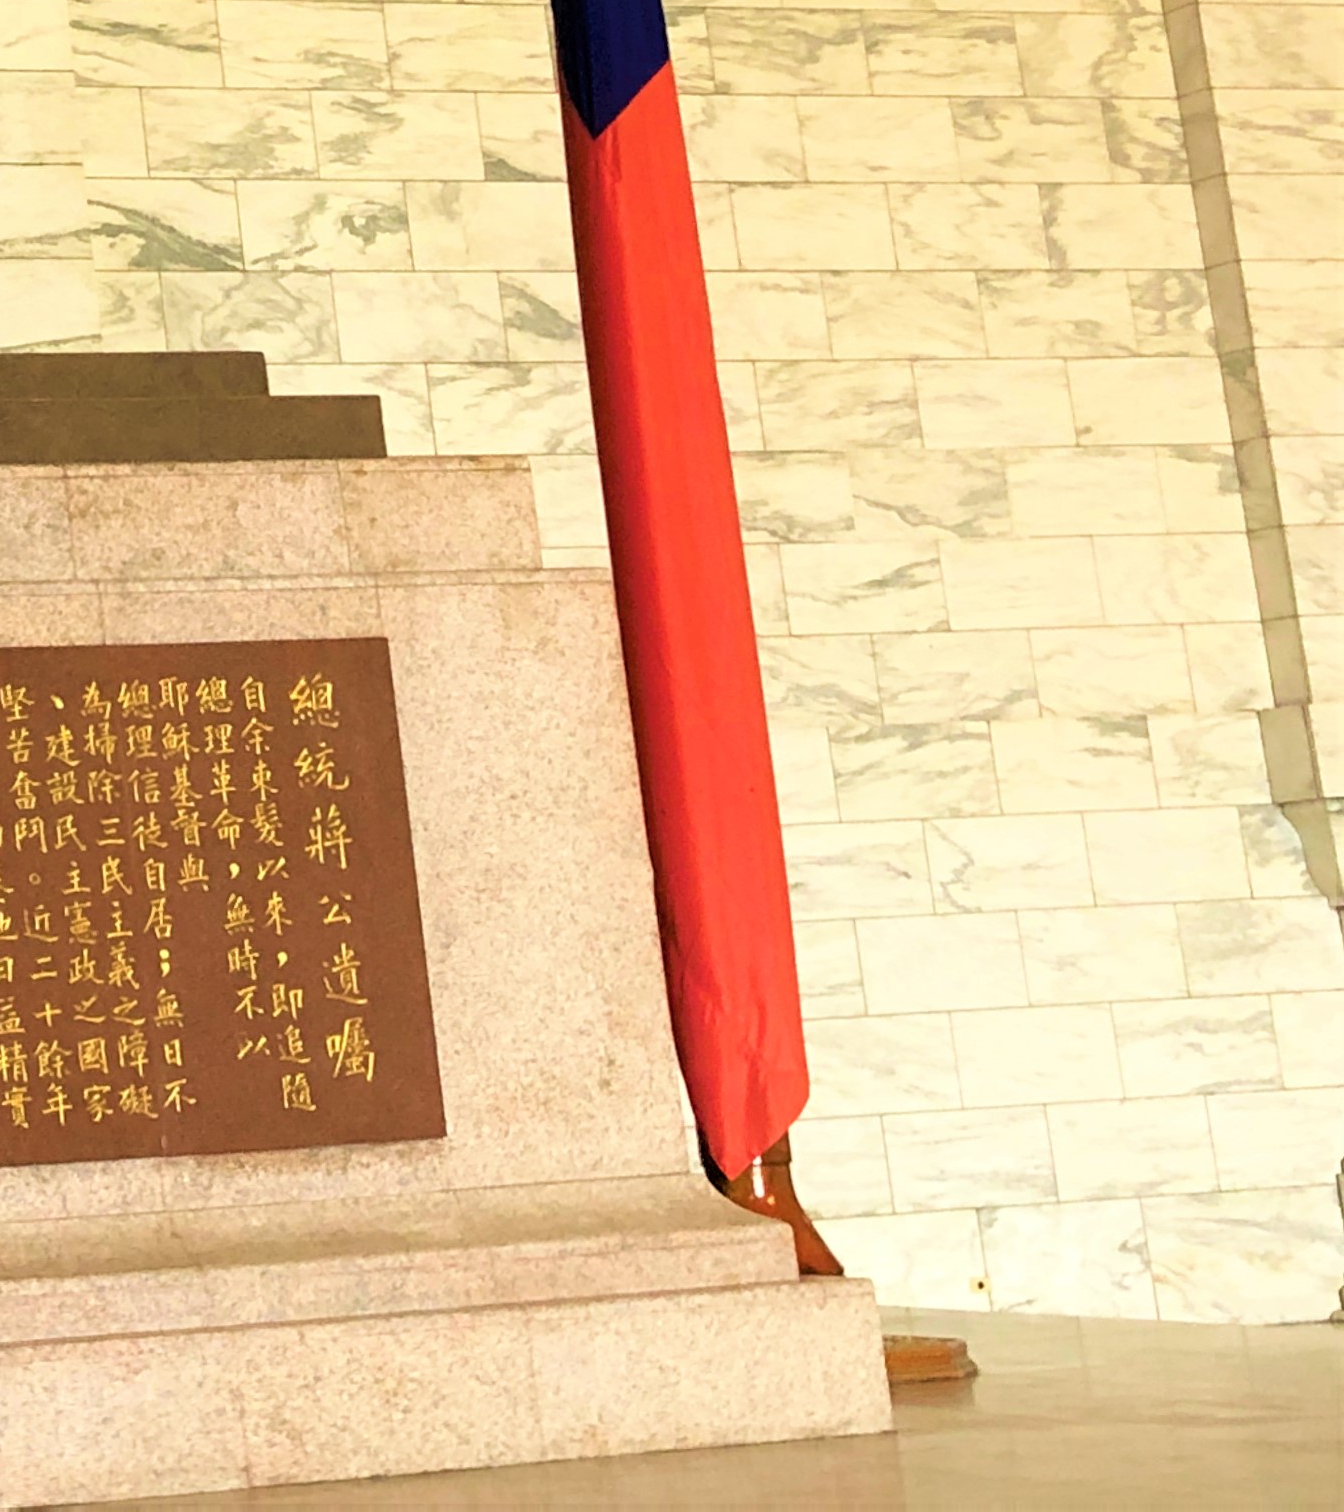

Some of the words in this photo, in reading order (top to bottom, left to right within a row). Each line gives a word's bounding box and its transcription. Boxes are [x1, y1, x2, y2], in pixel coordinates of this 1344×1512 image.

[289, 673, 375, 1082] 總統蔣公遺囑
